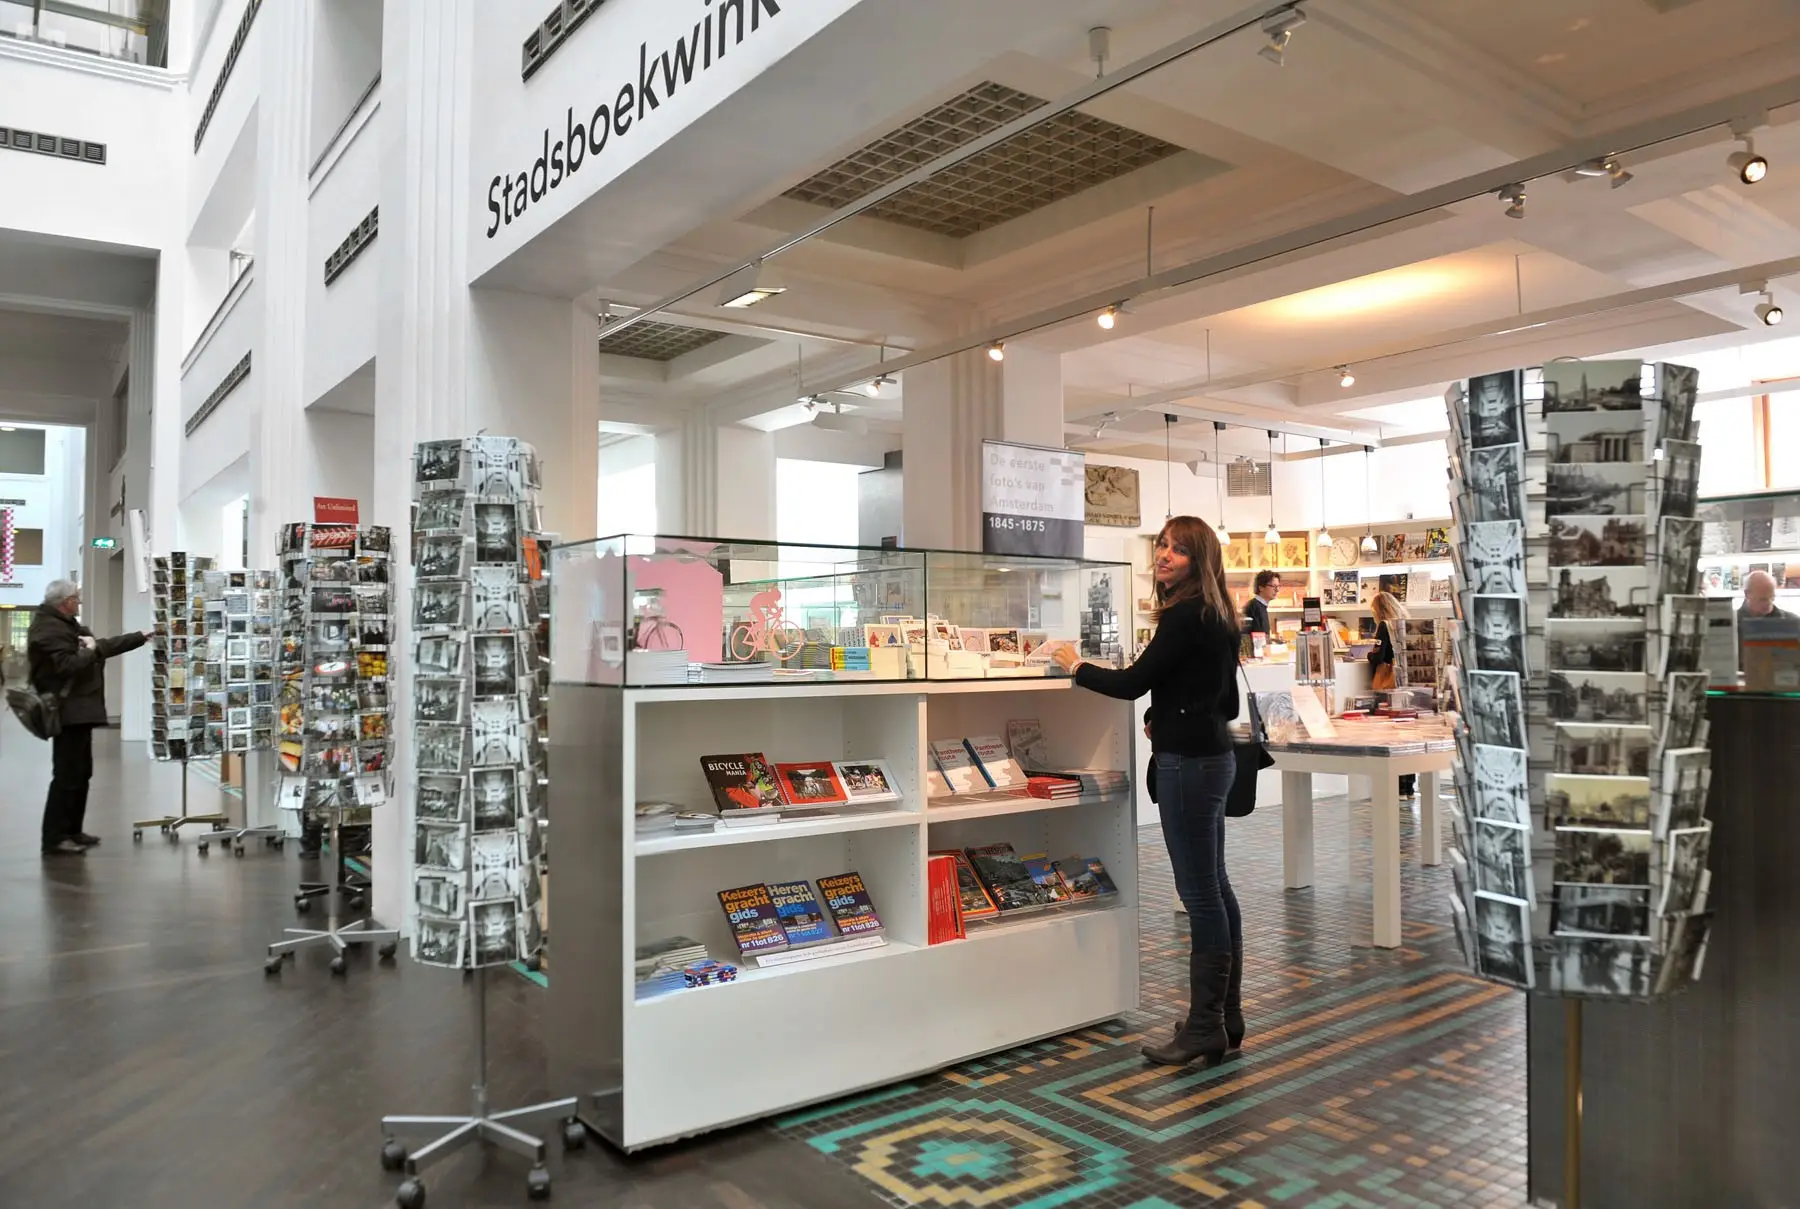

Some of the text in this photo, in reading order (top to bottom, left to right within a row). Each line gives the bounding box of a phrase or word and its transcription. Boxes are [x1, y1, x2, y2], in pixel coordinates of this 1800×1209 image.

[990, 453, 1045, 472] De eerste
[990, 473, 1045, 492] foto's van
[990, 495, 1054, 512] Amsterdam
[989, 516, 1045, 532] 1845-1875
[708, 762, 745, 771] BICYCLE
[767, 884, 808, 896] Heren
[820, 875, 860, 889] Keizers
[721, 886, 766, 901] Keizers
[772, 891, 814, 908] gracht
[825, 883, 865, 900] gracht
[725, 894, 770, 914] gracht
[777, 902, 805, 917] gids
[829, 895, 855, 909] gids
[730, 908, 759, 924] gids
[756, 938, 767, 946] tot
